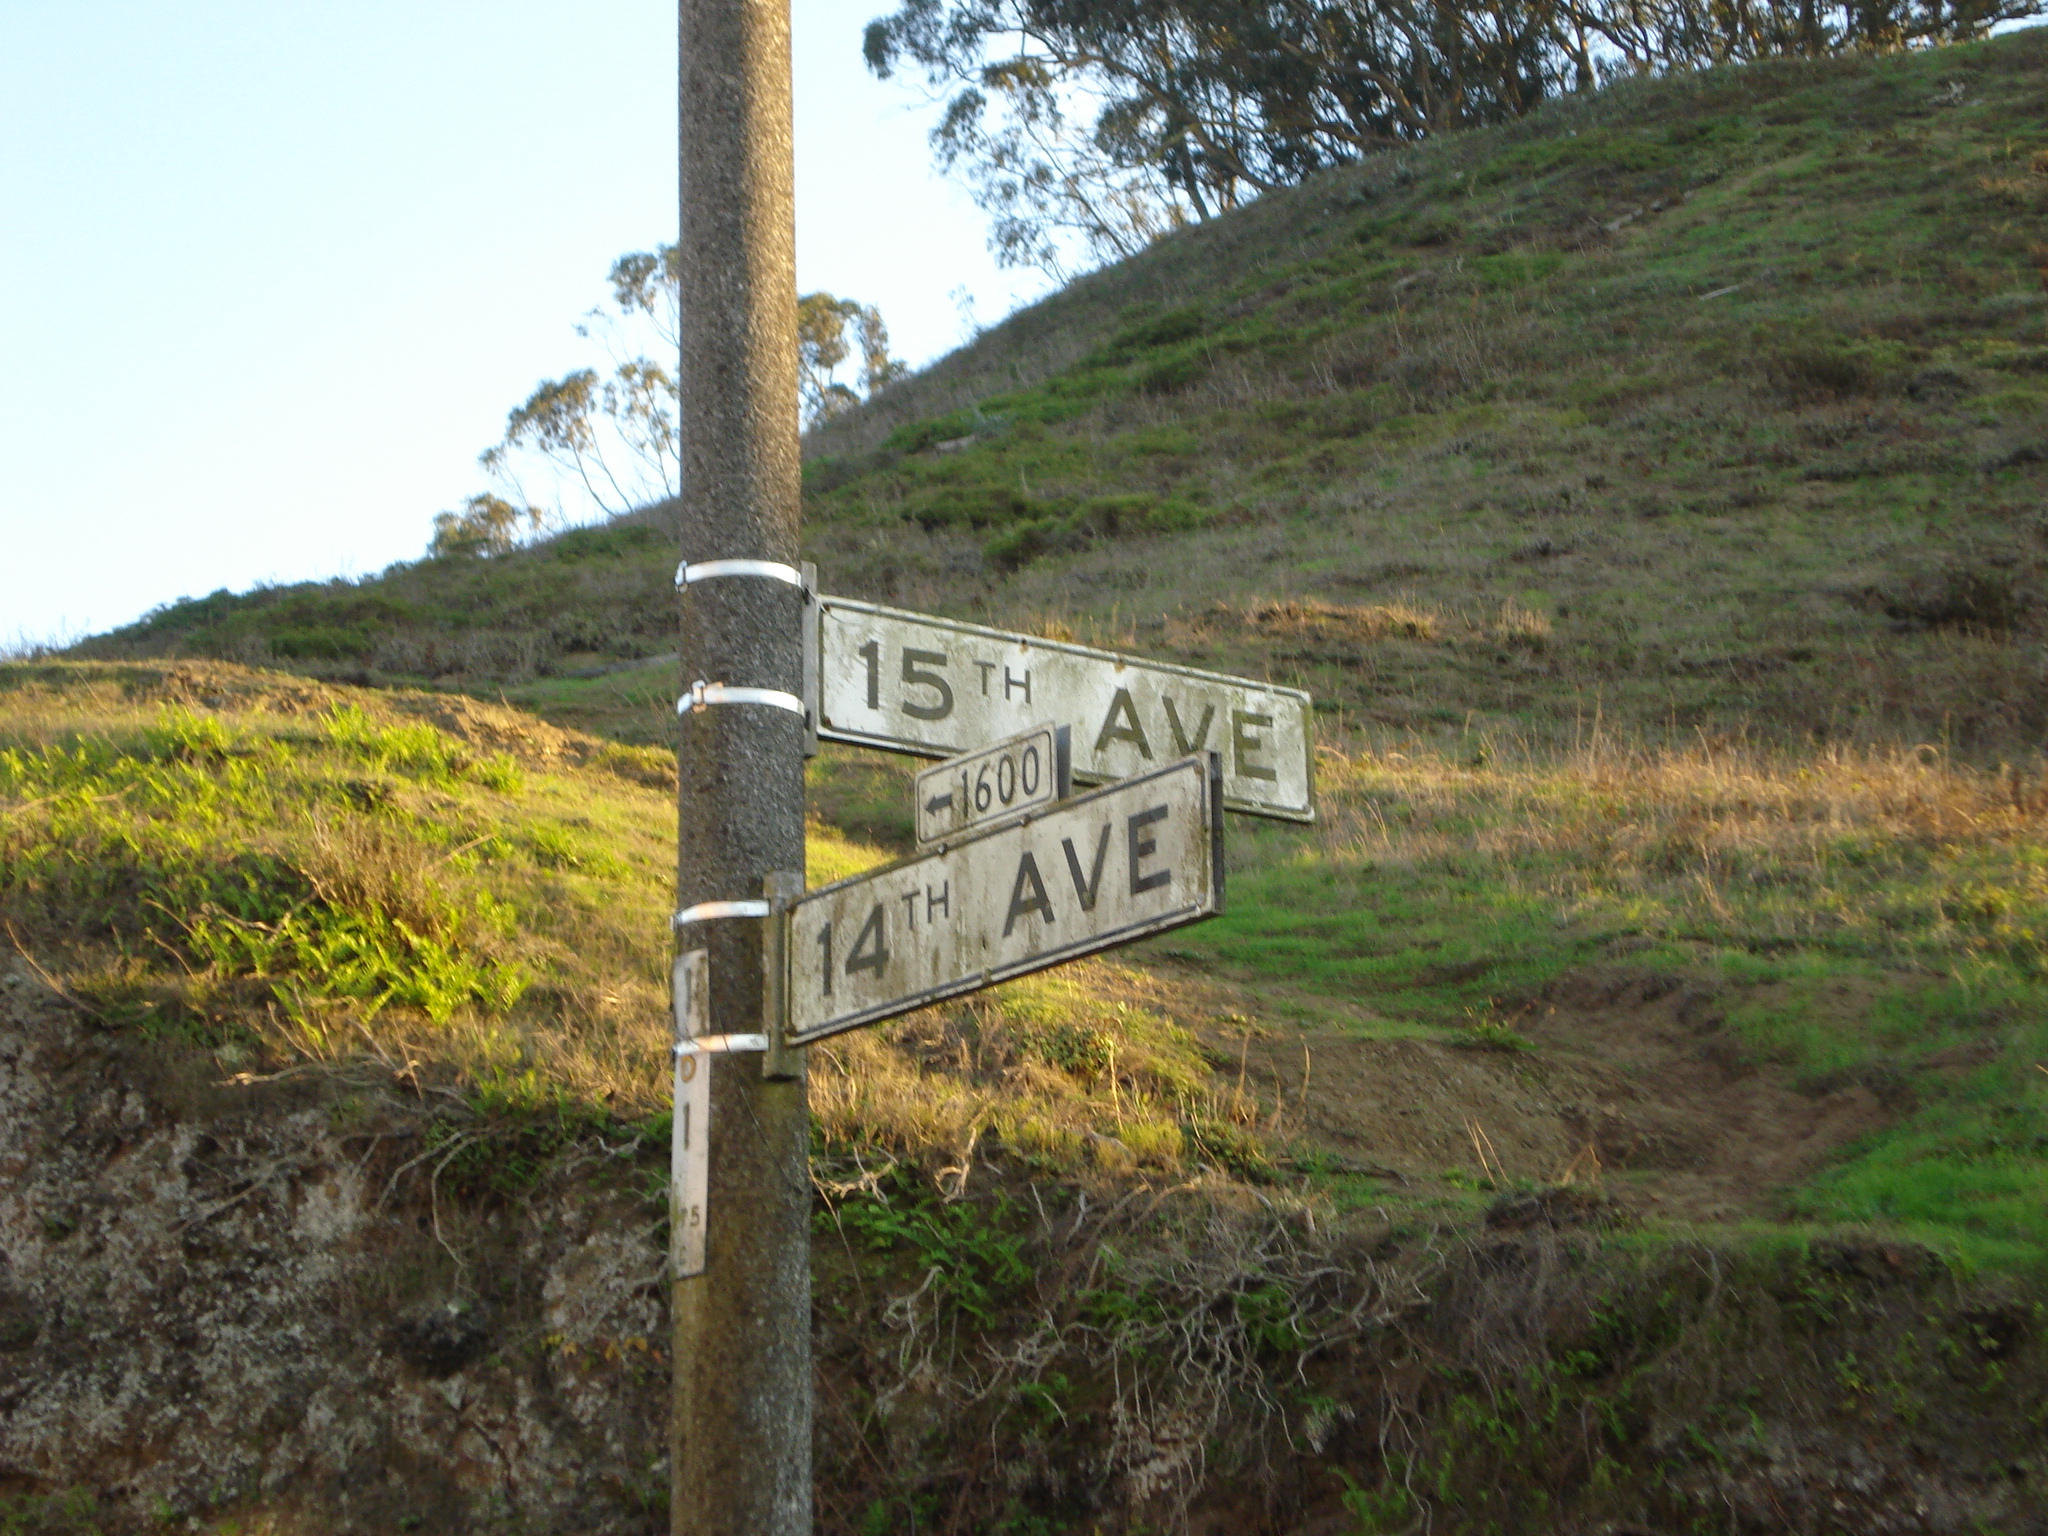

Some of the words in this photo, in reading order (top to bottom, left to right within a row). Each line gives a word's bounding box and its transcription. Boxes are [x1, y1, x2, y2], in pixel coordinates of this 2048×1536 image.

[859, 641, 1032, 720] 15TH
[1095, 688, 1277, 780] AVE
[962, 745, 1041, 817] 1600
[818, 880, 949, 995] 14TH
[1004, 806, 1170, 938] AVE
